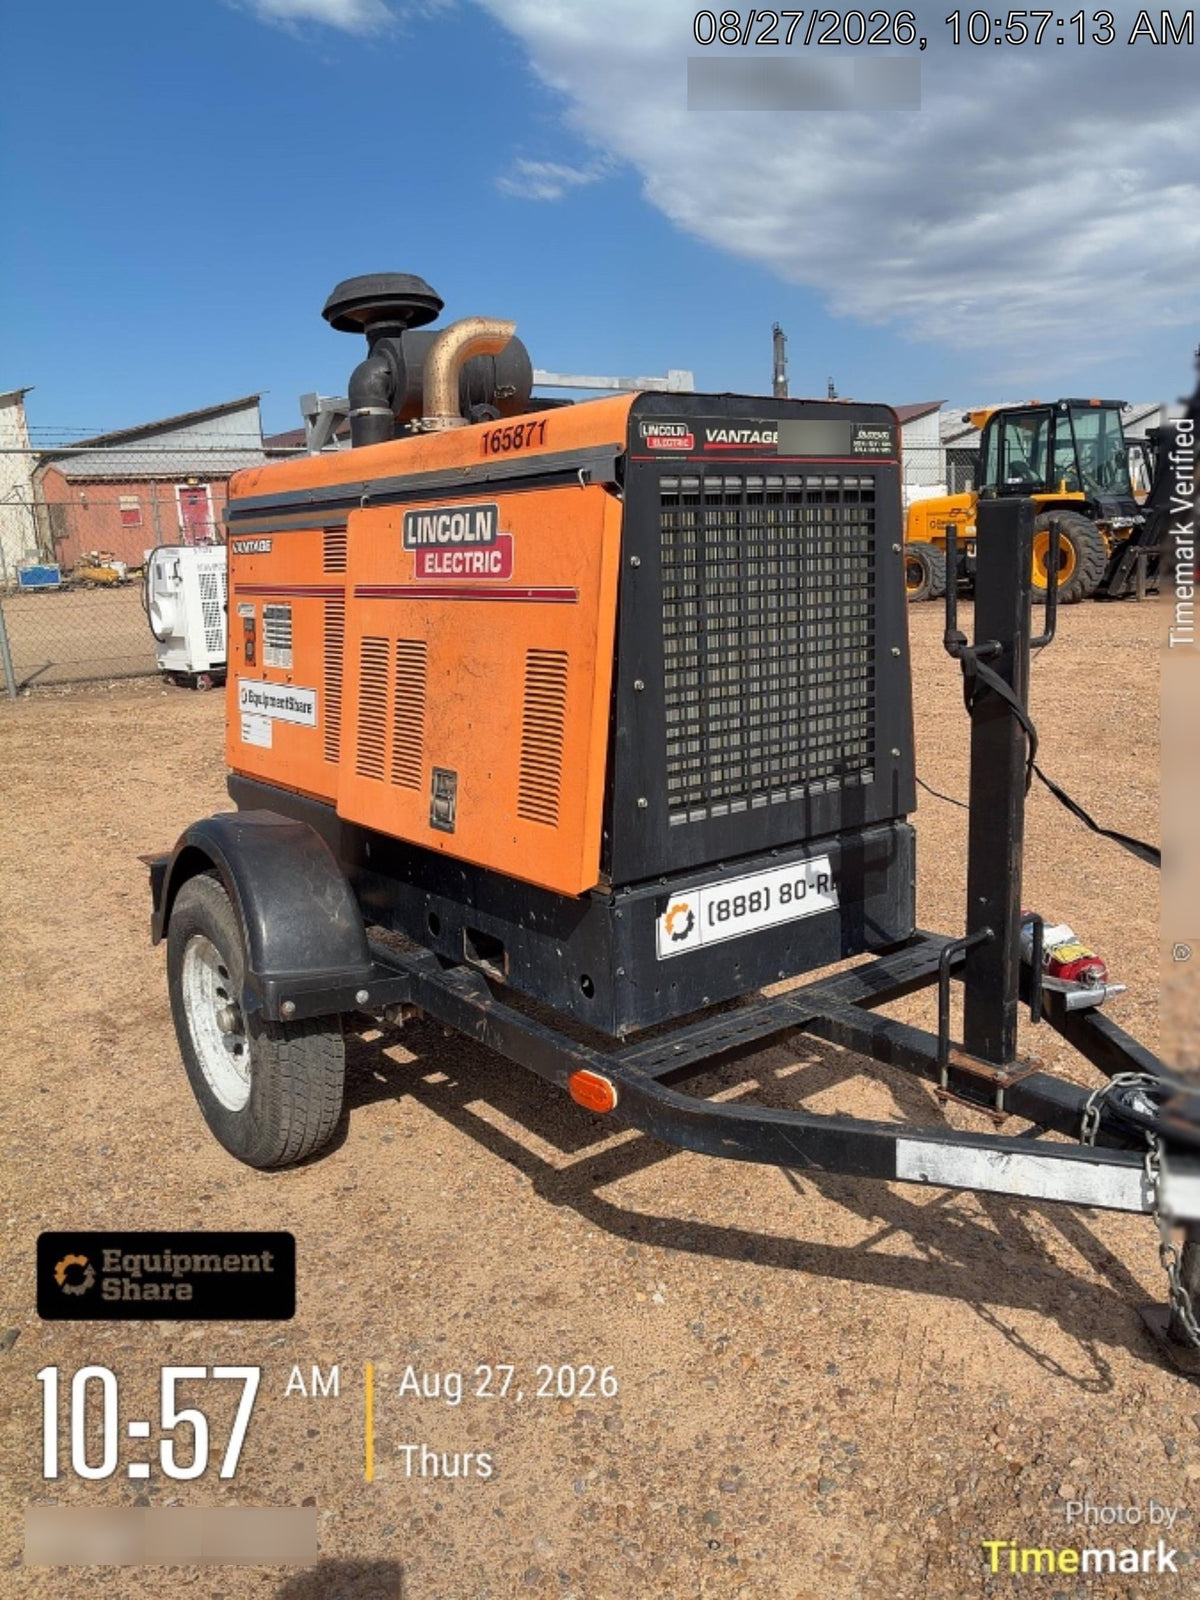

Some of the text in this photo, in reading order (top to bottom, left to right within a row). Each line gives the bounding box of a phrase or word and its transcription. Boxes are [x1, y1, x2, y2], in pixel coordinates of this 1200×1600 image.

[482, 419, 548, 455] 165871
[642, 424, 686, 437] LINCOLN
[652, 438, 690, 448] ELECTRIC
[407, 511, 493, 545] LINCOLN
[424, 550, 502, 574] ELECTRIC
[708, 873, 835, 927] (888) 80-R
